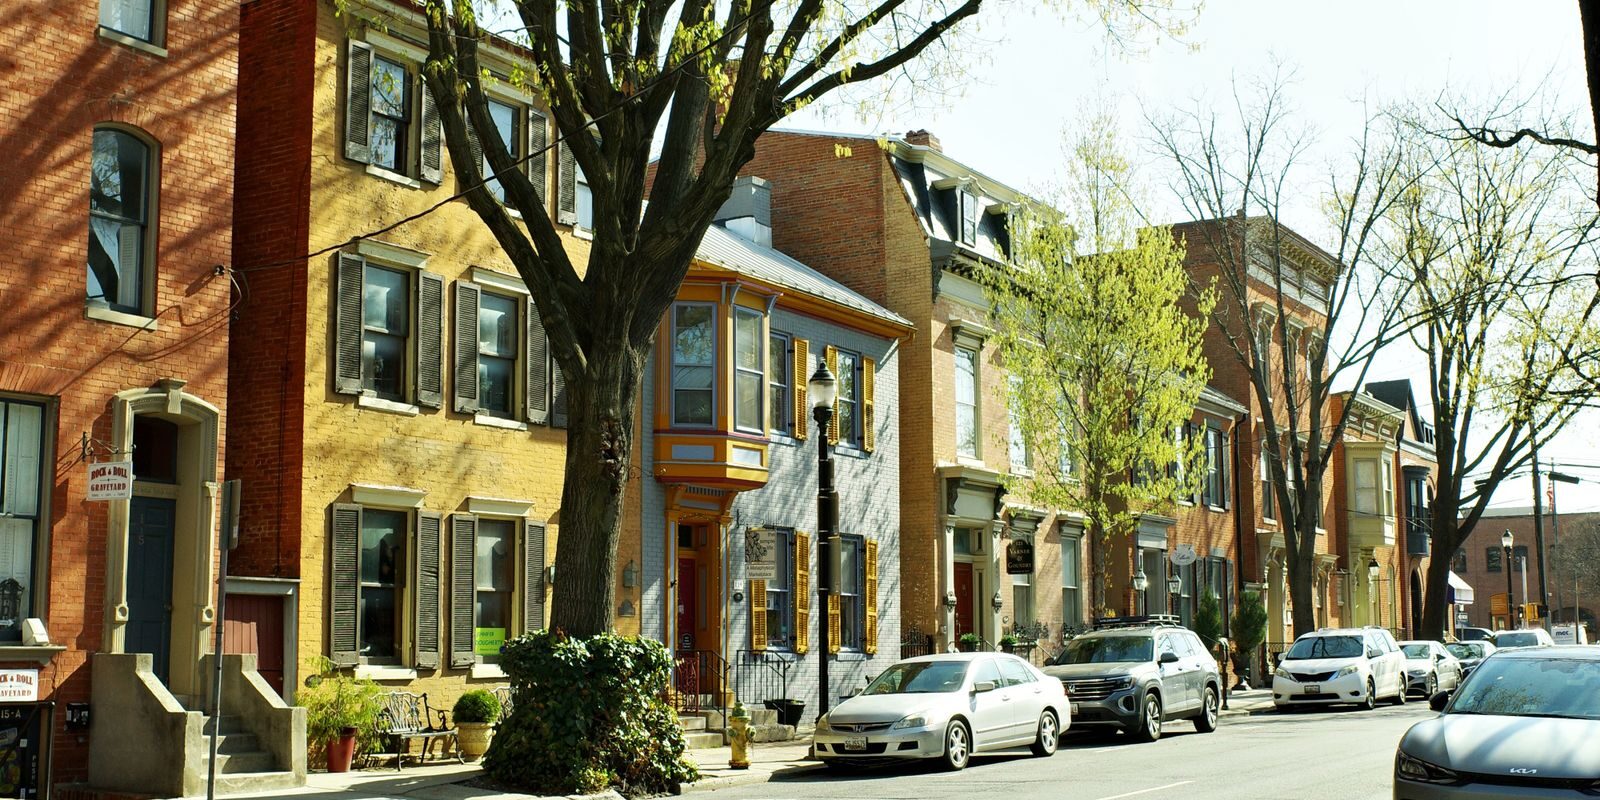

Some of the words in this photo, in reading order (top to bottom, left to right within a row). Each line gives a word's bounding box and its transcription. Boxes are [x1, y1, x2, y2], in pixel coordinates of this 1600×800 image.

[91, 467, 106, 480] ROCK
[113, 466, 127, 478] ROLL
[91, 483, 126, 491] GRAVEYARD
[16, 674, 33, 685] ROLL
